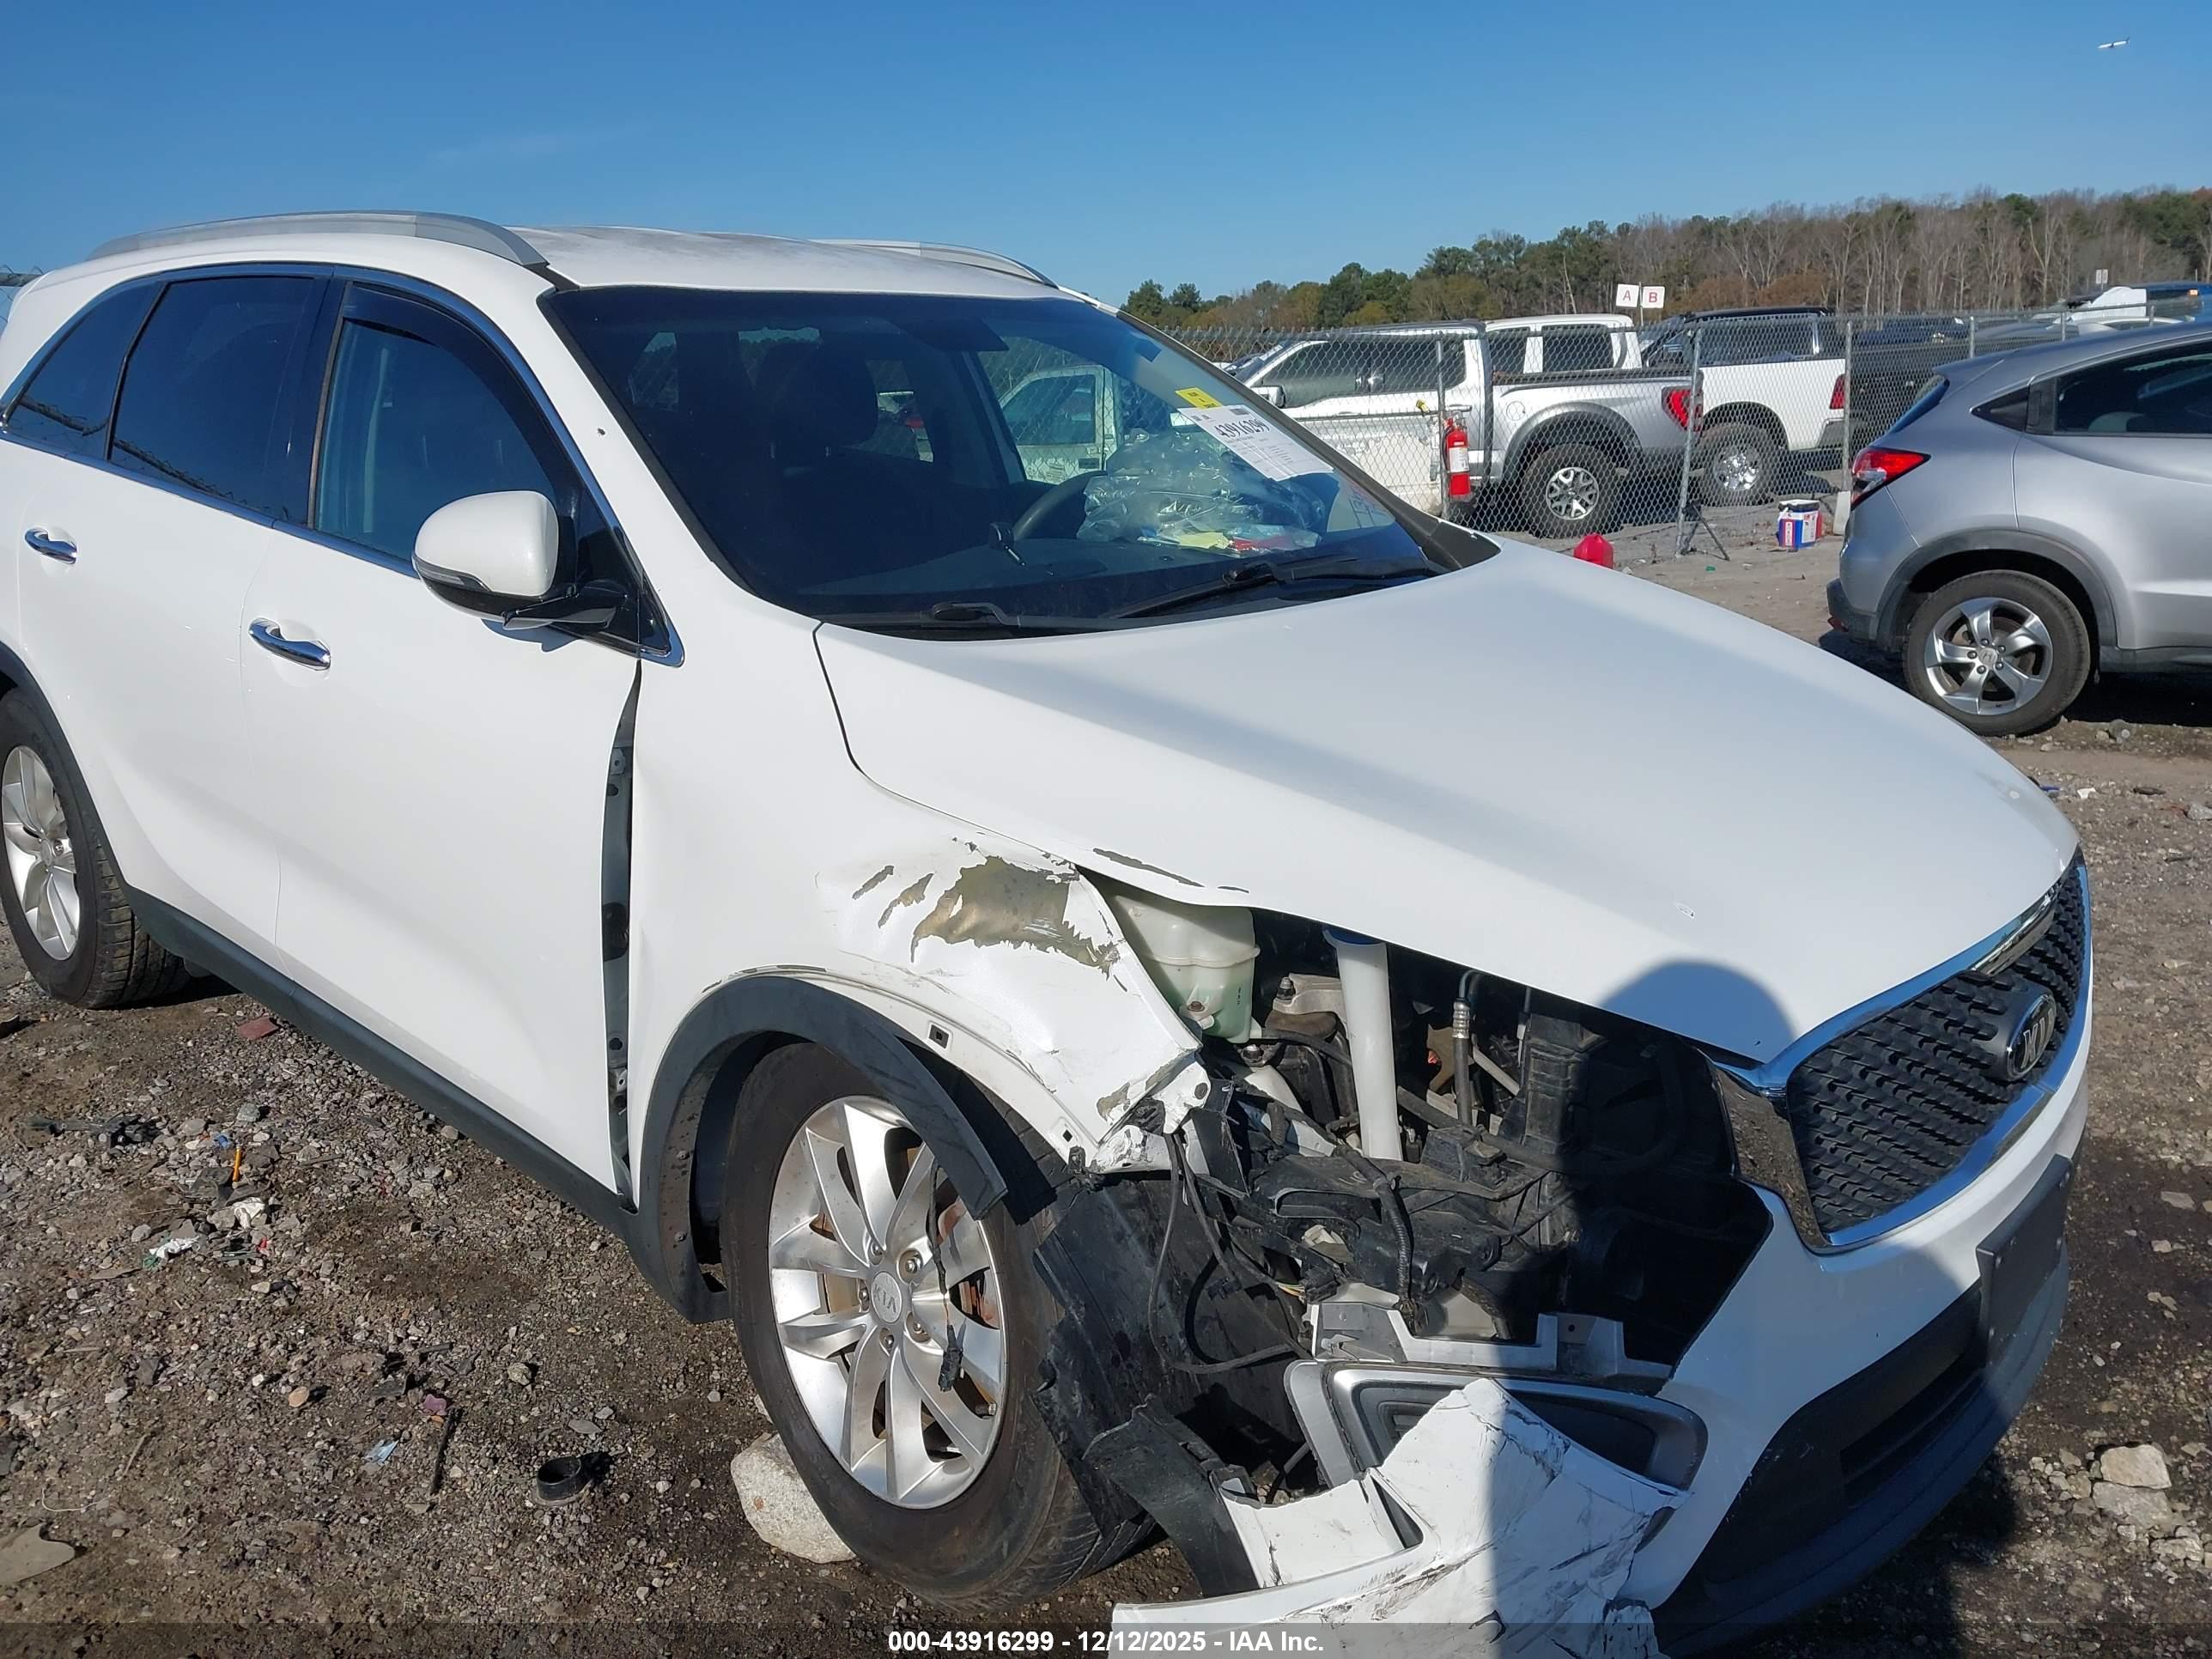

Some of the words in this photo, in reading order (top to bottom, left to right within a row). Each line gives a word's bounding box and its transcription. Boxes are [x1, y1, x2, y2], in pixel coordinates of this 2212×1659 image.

[1622, 289, 1632, 301] A
[1649, 291, 1658, 303] B
[1214, 418, 1270, 438] 43916299
